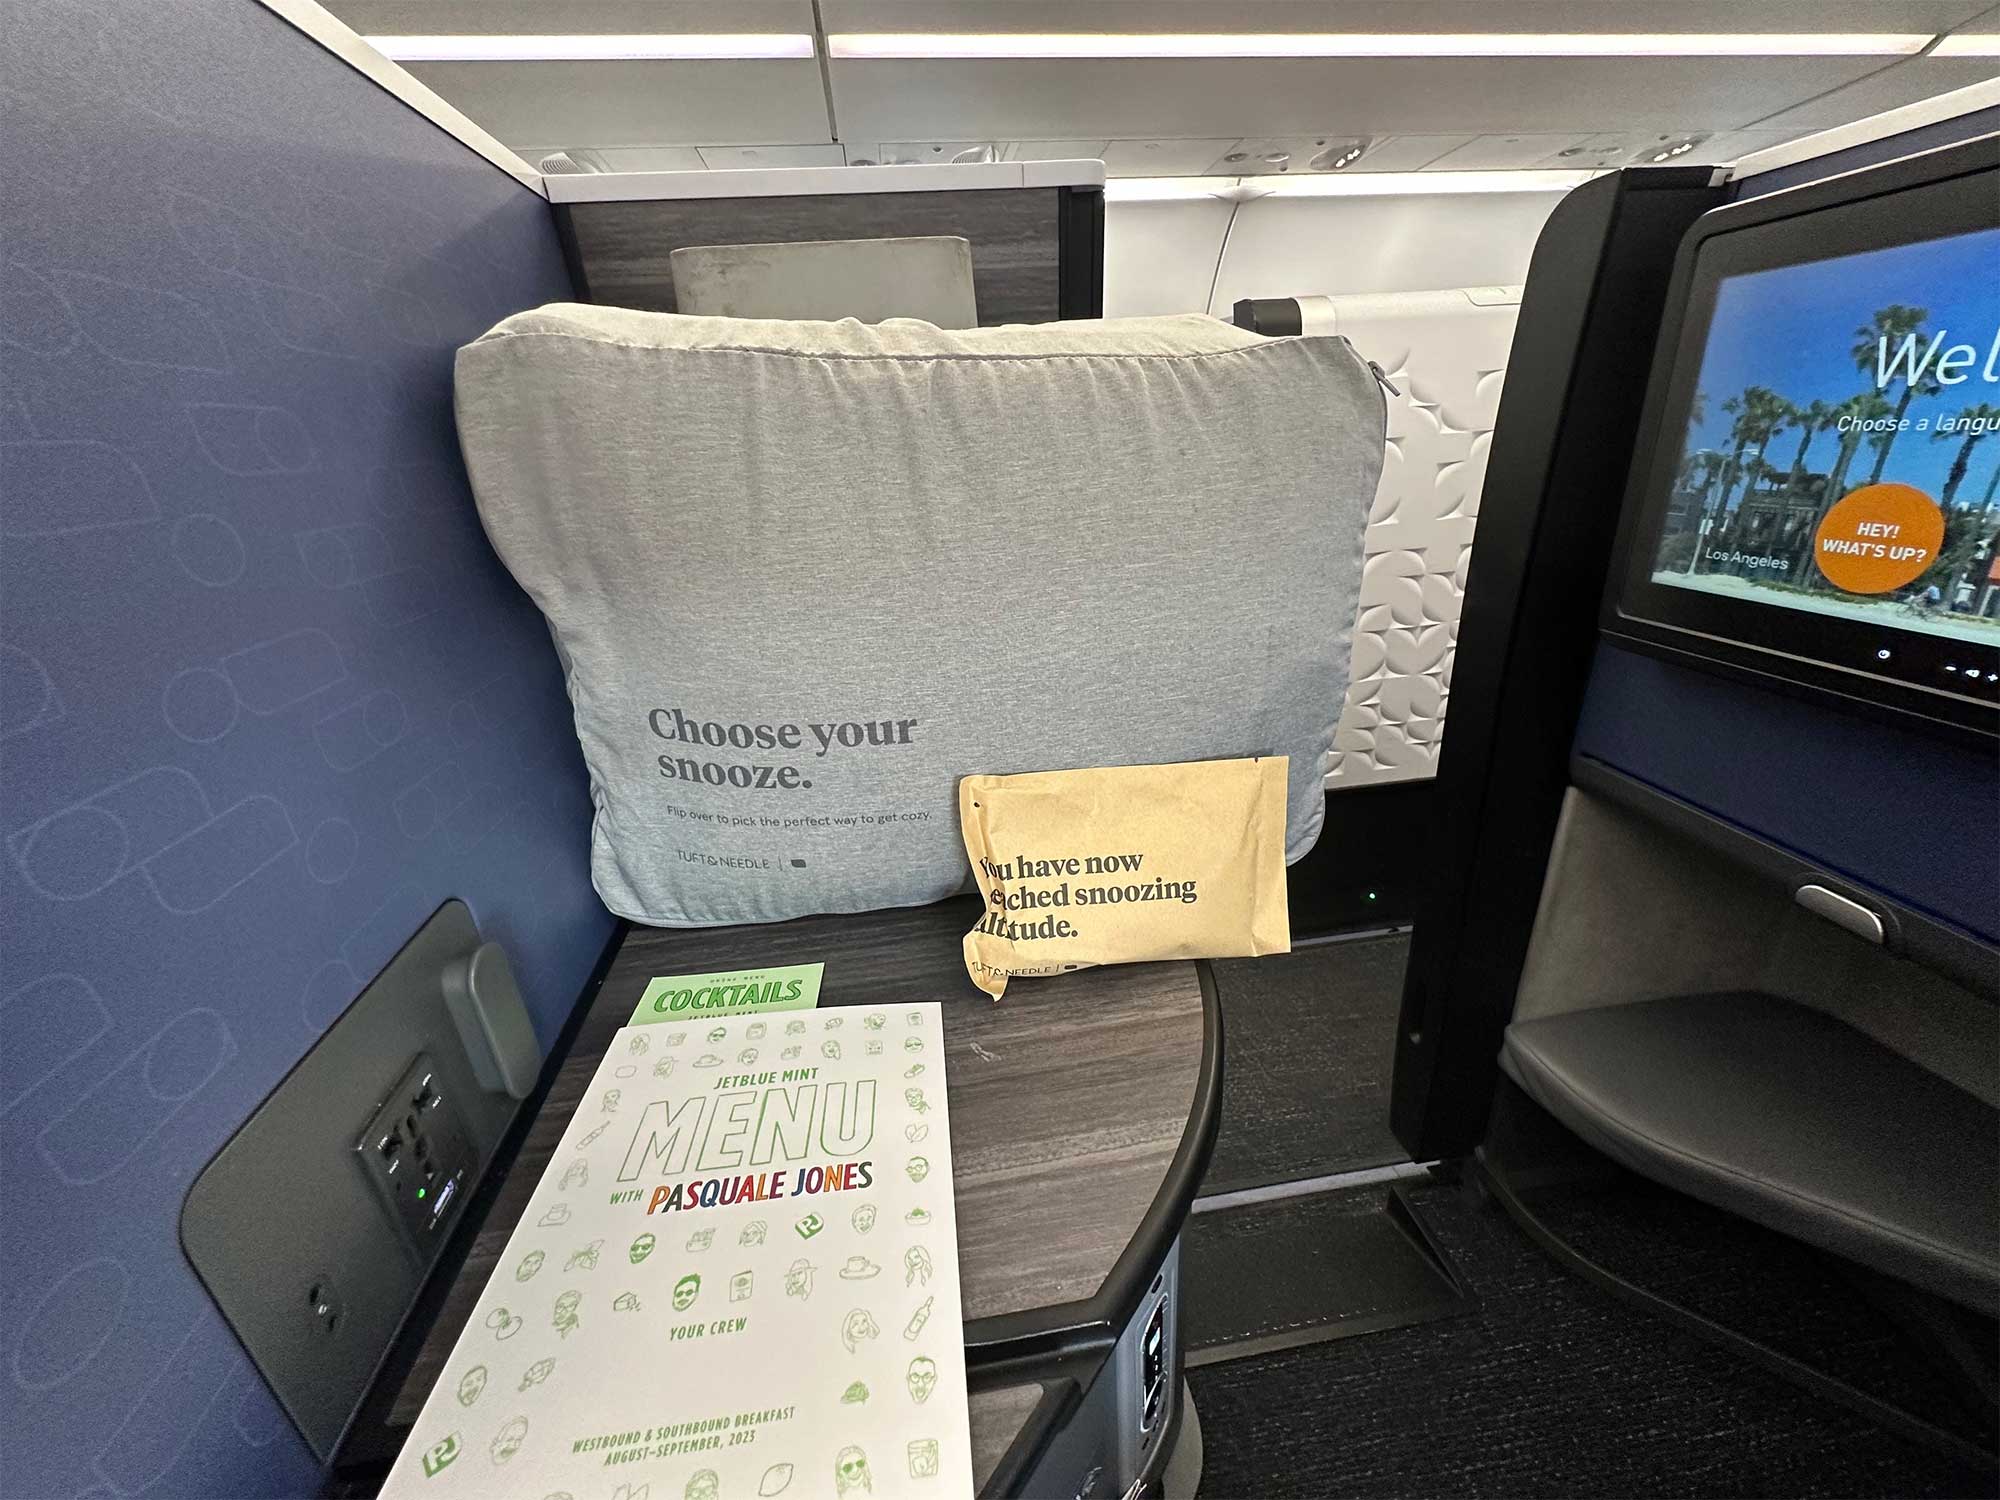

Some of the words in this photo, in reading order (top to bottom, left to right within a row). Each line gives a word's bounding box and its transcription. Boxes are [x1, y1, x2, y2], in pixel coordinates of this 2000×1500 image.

[1836, 414, 1908, 433] Choose
[1915, 419, 1927, 432] a
[1857, 521, 1900, 540] HEY!
[1705, 547, 1729, 562] Los
[1731, 550, 1789, 571] Angeles
[1823, 538, 1885, 559] WHAT'S
[1889, 546, 1927, 564] UP?
[649, 708, 801, 750] Choose
[808, 718, 917, 757] your
[657, 754, 813, 789] snooze.
[667, 805, 687, 819] Flip
[689, 811, 713, 823] over
[716, 814, 729, 825] to
[732, 816, 757, 828] pick
[760, 816, 780, 827] the
[784, 816, 831, 829] perfect
[833, 817, 858, 827] way
[861, 814, 875, 825] to
[878, 812, 898, 825] get
[901, 810, 933, 822] cozy.
[979, 856, 1014, 881] You
[1016, 855, 1081, 879] have
[1084, 854, 1144, 875] now
[1074, 877, 1197, 906] snoozing
[653, 979, 803, 1013] COCKTAILS
[713, 1071, 778, 1090] JETBLUE
[782, 1067, 819, 1082] MINT
[616, 1079, 877, 1183] MENU
[609, 1189, 644, 1205] WITH
[647, 1170, 788, 1216] PASQUALE
[791, 1161, 873, 1197] JONES
[669, 1323, 705, 1341] YOUR
[710, 1317, 748, 1336] CREW
[572, 1430, 641, 1454] WESTBOUND
[645, 1429, 652, 1442] &
[656, 1416, 731, 1442] SOUTHBOUND
[734, 1406, 797, 1429] BREAKFAST
[728, 1429, 757, 1445] 2023
